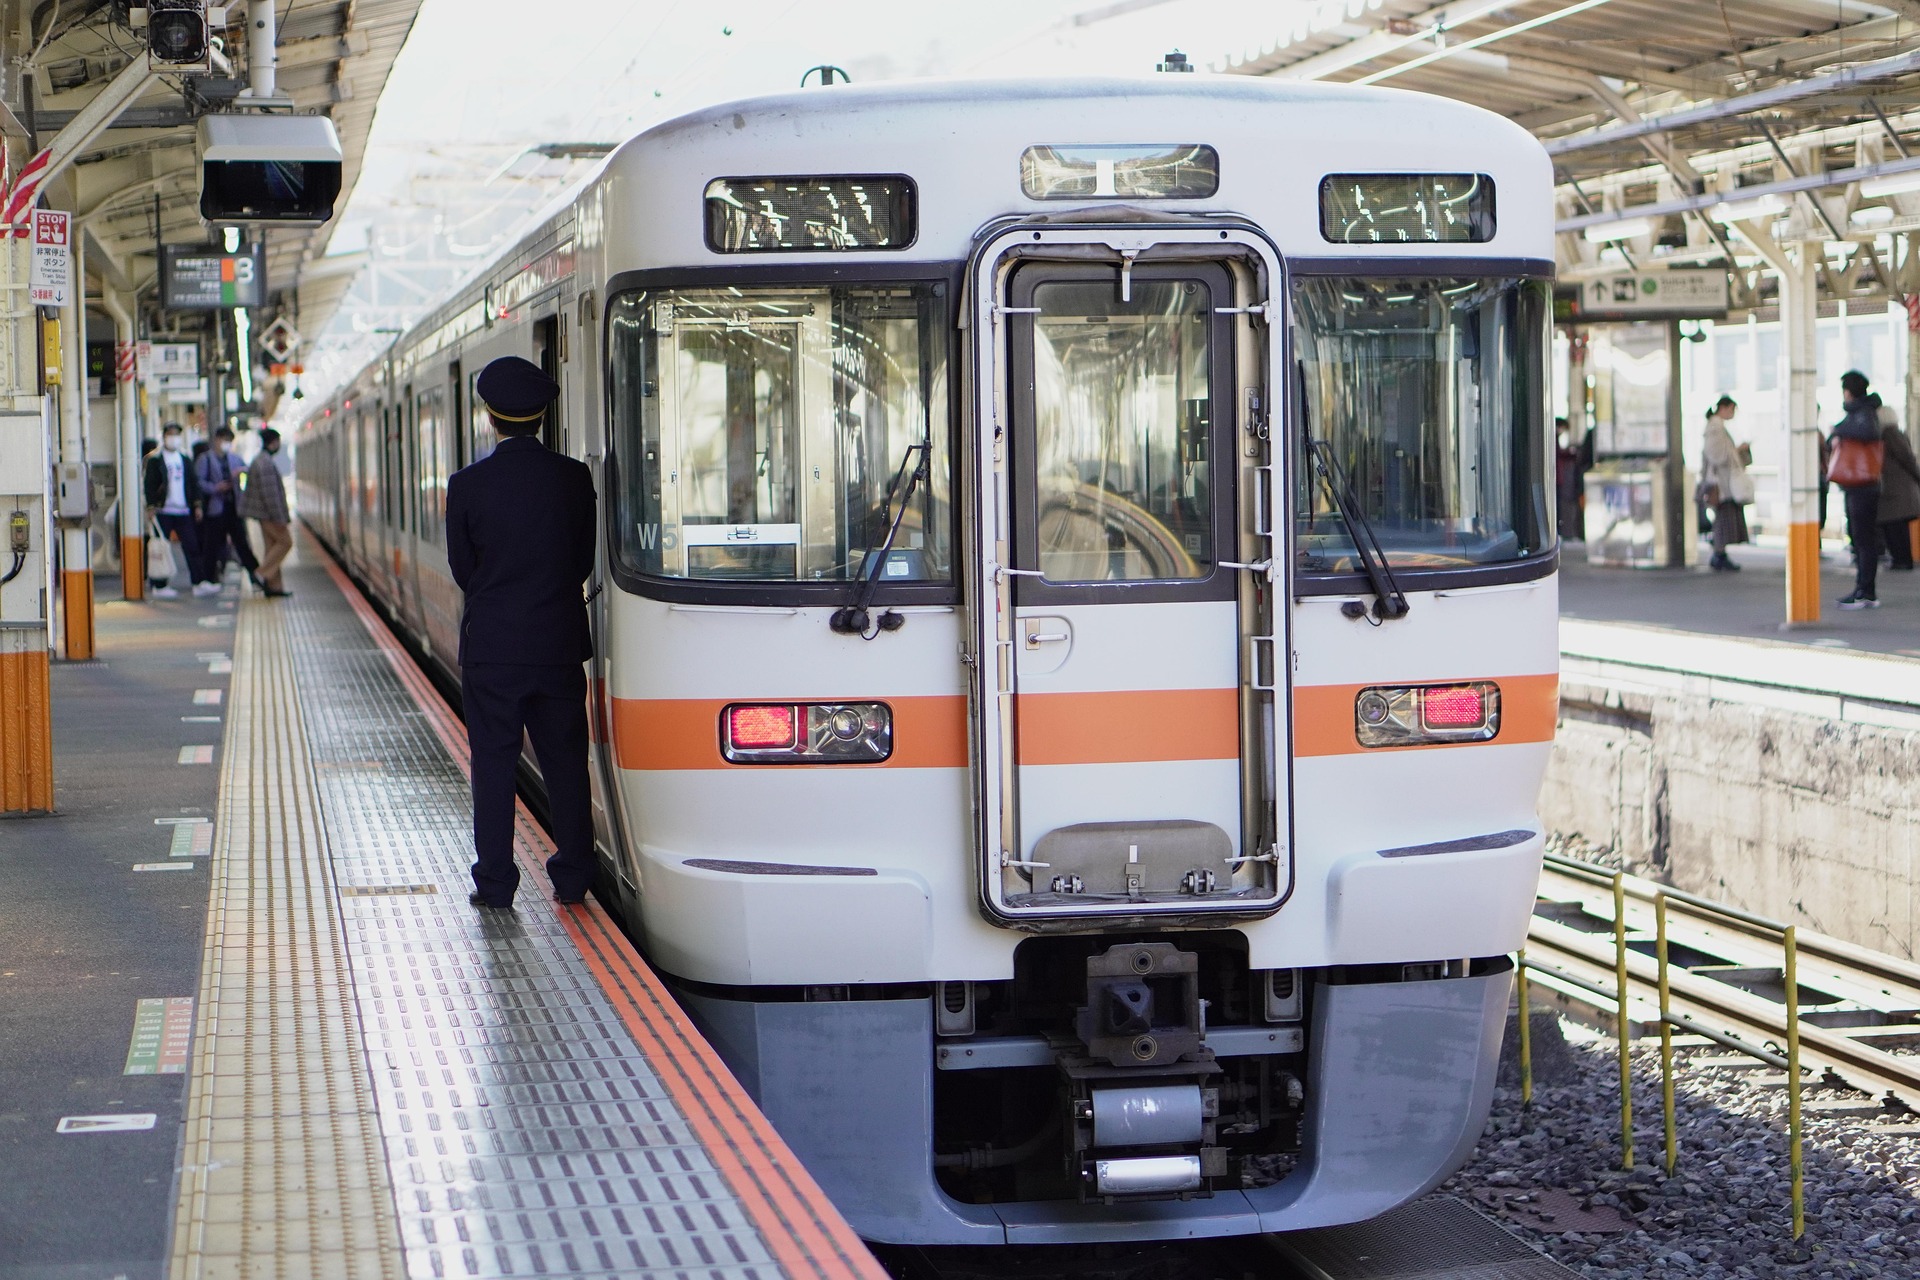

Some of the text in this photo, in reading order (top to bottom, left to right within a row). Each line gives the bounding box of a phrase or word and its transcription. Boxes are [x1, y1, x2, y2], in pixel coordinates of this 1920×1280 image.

[38, 214, 66, 224] STOP
[36, 247, 66, 257] 非常停止
[44, 258, 66, 267] ボタン
[238, 257, 254, 285] 3
